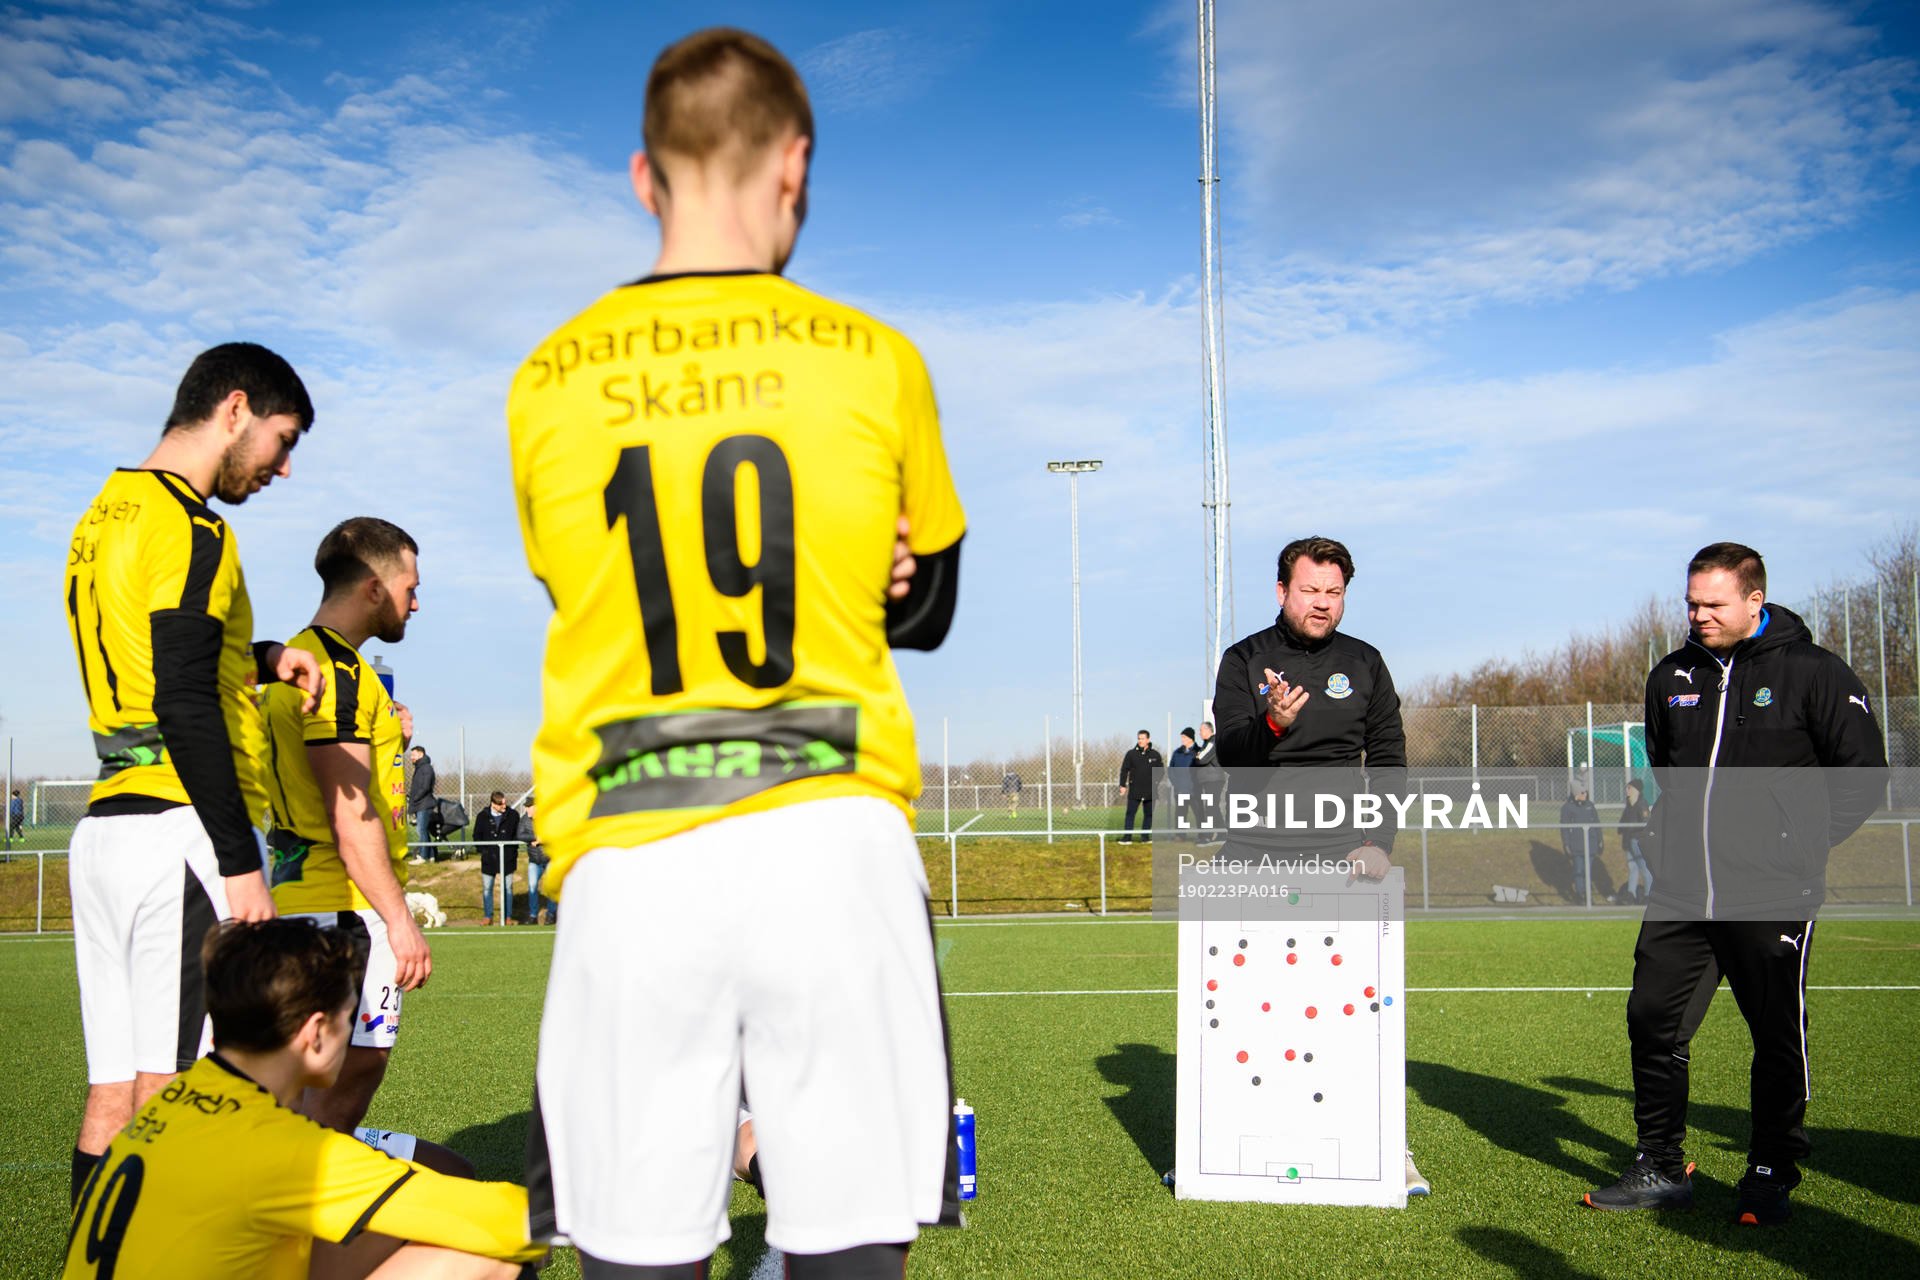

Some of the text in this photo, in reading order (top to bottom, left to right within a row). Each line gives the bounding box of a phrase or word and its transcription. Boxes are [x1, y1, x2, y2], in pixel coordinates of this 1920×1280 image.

[602, 362, 784, 426] Skåne
[603, 434, 796, 697] 19
[1382, 893, 1390, 937] FOOTBALL
